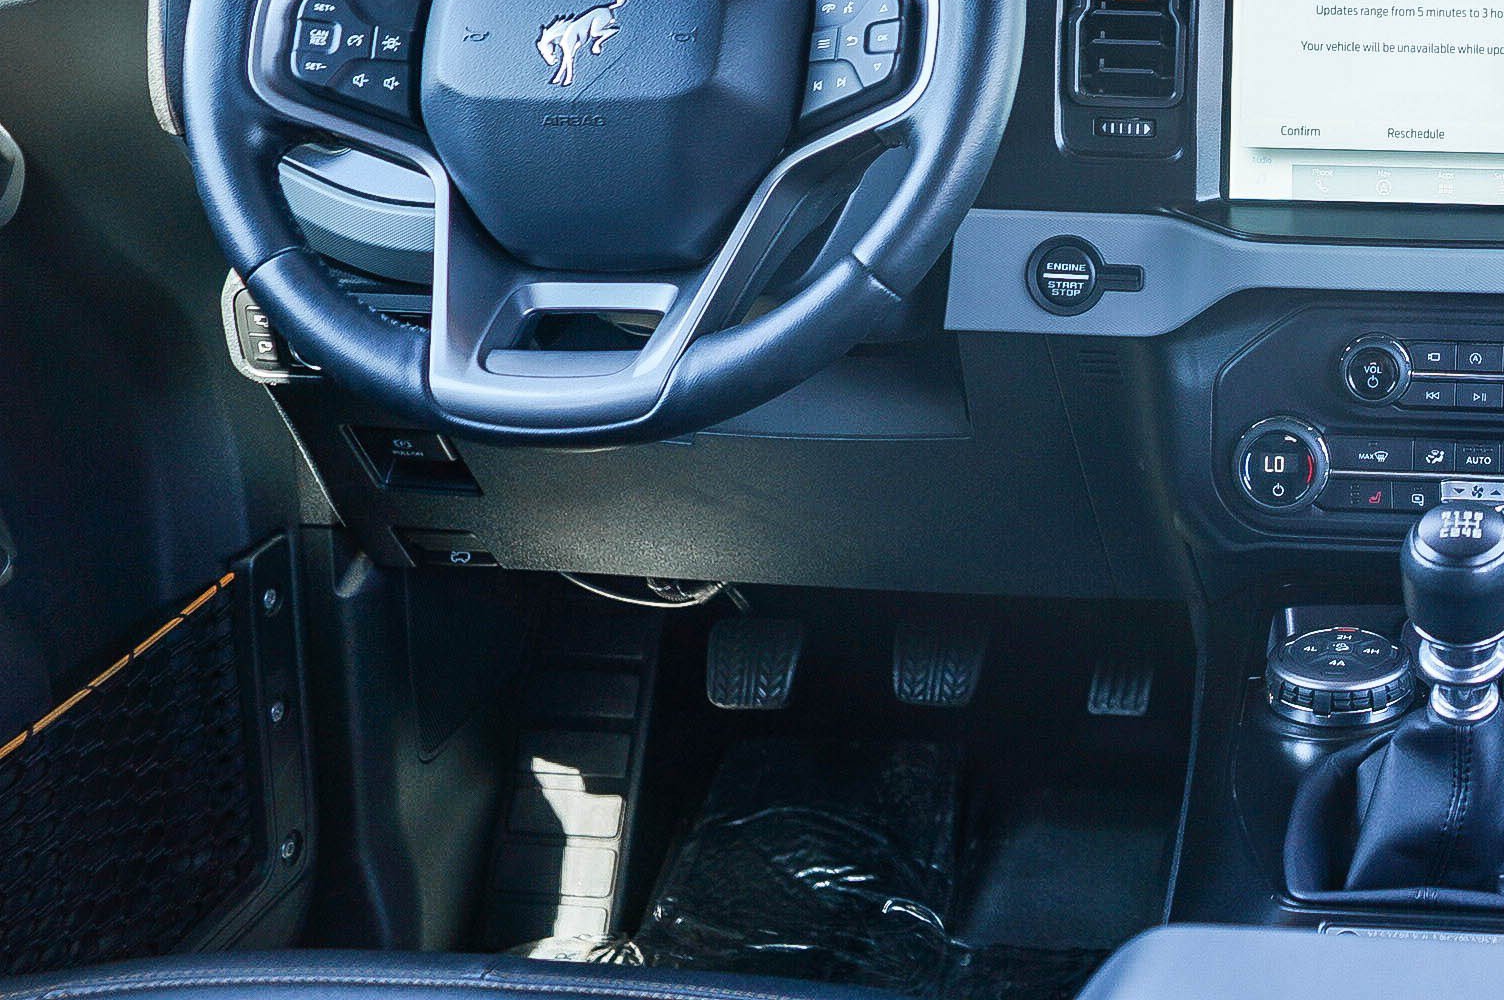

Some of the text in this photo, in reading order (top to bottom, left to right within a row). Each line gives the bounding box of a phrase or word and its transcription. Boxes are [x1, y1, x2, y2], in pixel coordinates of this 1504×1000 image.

[1315, 4, 1359, 18] Updates
[1360, 7, 1389, 20] range
[1390, 6, 1416, 17] from
[1417, 7, 1424, 17] 5
[1426, 7, 1467, 18] minutes
[1469, 8, 1480, 18] to
[1481, 8, 1489, 19] 3
[1300, 40, 1324, 52] Your
[1325, 41, 1361, 53] vehicle
[1362, 42, 1381, 53] will
[1382, 42, 1396, 53] be
[1397, 42, 1456, 55] unavailable
[1457, 44, 1485, 55] while
[541, 114, 605, 128] AIRBAG
[1280, 125, 1321, 137] Confirm
[1387, 127, 1445, 140] Reschedule
[1046, 262, 1086, 272] ENGINE
[1047, 280, 1084, 289] START
[1051, 288, 1081, 297] STOP
[1364, 365, 1382, 375] VOL
[1358, 453, 1374, 461] MAX
[1466, 456, 1492, 466] AUTO
[1264, 455, 1285, 473] LO
